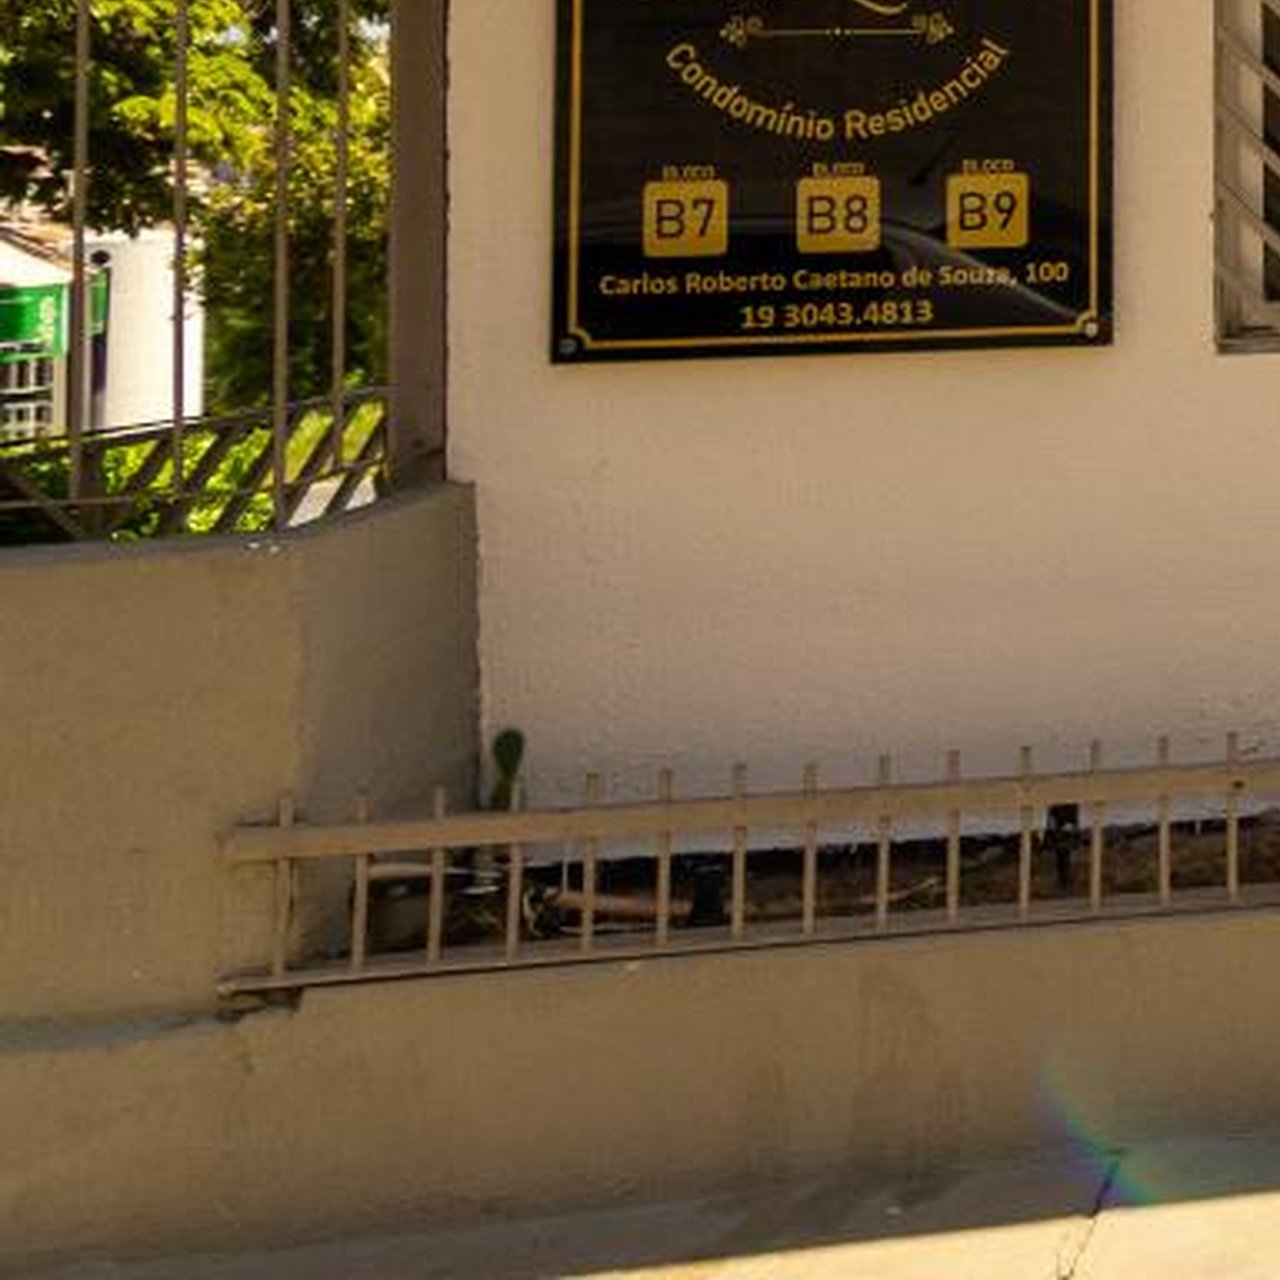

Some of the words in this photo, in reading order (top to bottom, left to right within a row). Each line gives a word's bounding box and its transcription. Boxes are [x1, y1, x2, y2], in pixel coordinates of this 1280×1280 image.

[844, 37, 1011, 141] Residencial
[655, 198, 716, 239] B7
[807, 195, 869, 235] B8
[959, 191, 1017, 231] B9
[600, 273, 678, 295] Carlos
[685, 270, 787, 293] Roberto
[793, 268, 895, 290] Caetano
[902, 265, 932, 287] de
[1025, 261, 1069, 283] 100
[740, 305, 775, 330] 19
[783, 300, 934, 328] 3043.4813
